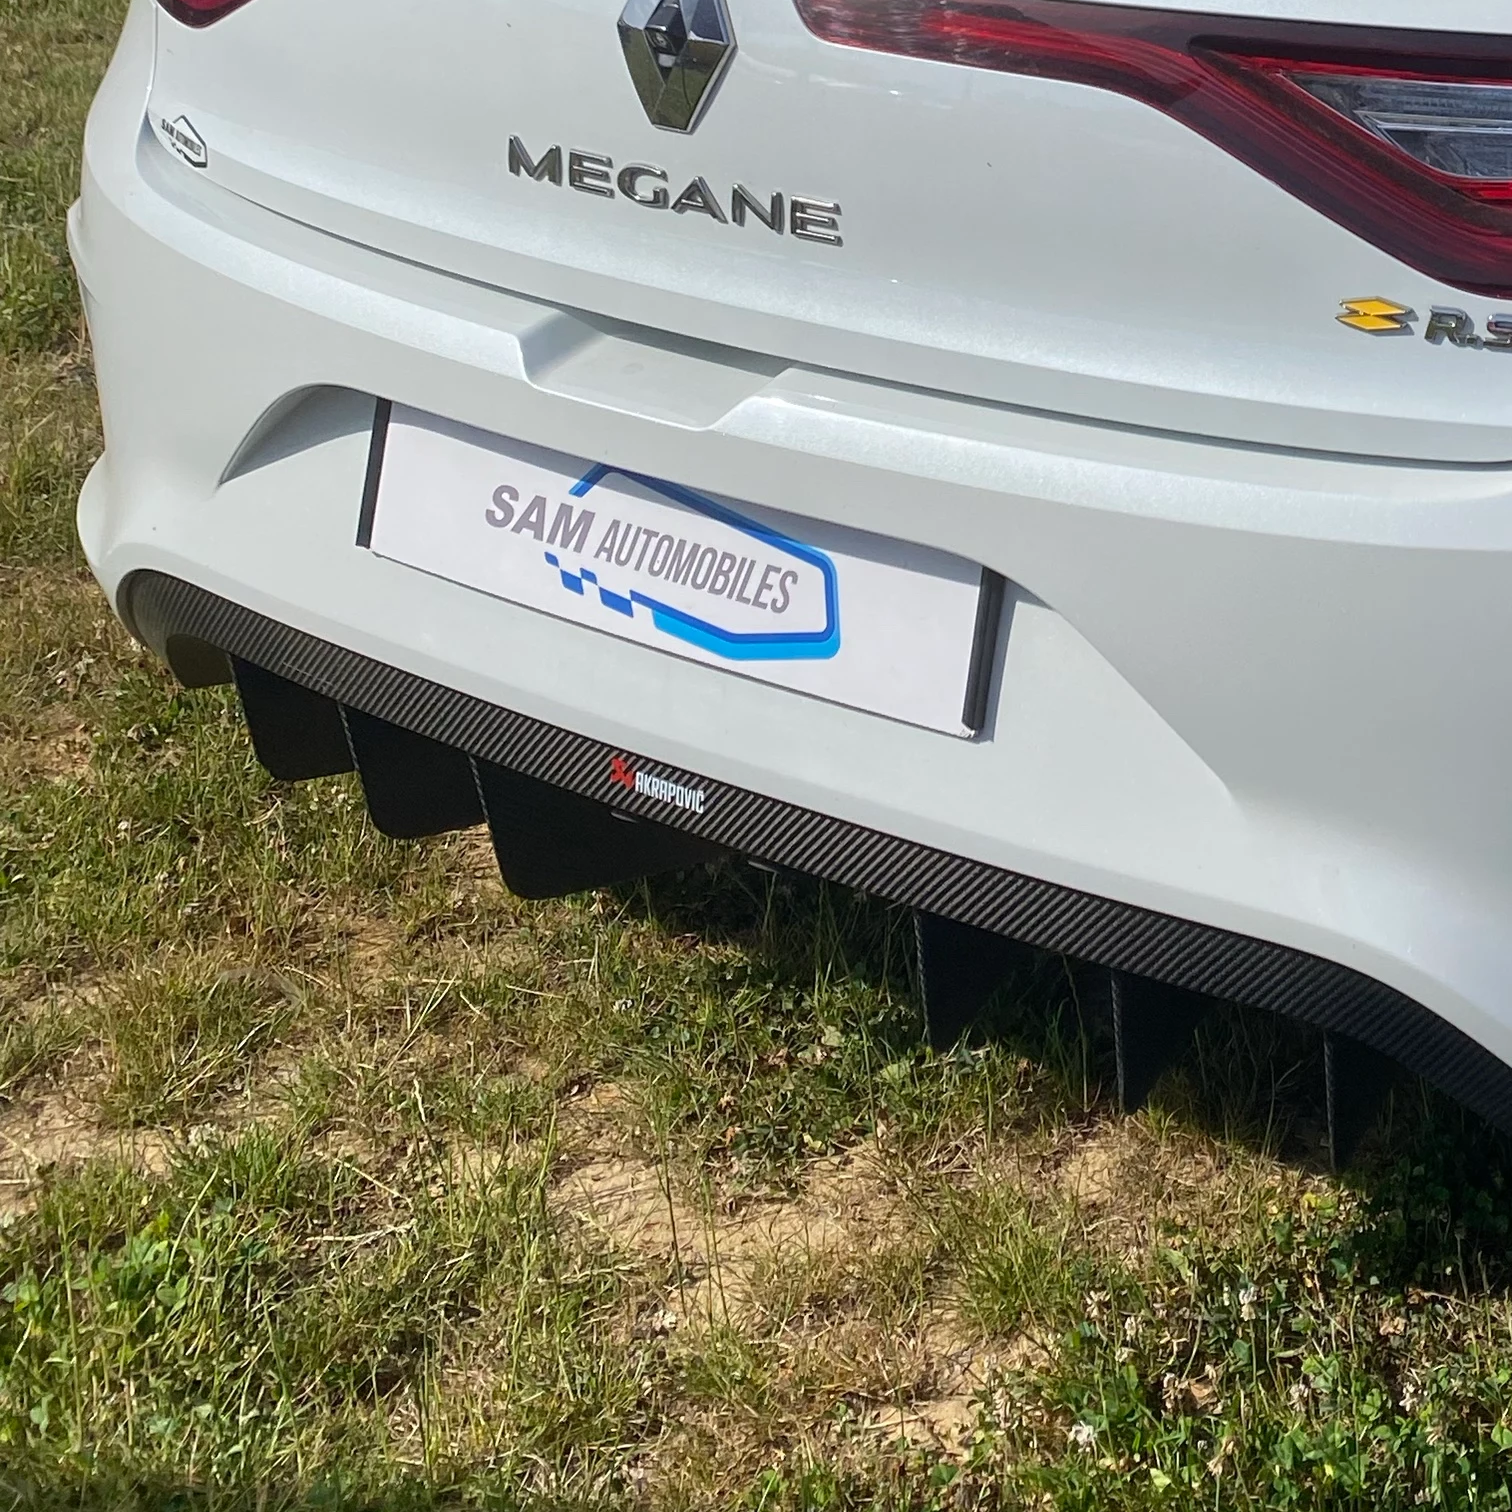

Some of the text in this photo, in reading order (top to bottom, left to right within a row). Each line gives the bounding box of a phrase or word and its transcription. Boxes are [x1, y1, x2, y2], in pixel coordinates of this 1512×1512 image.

[508, 134, 843, 247] MEGANE
[485, 484, 798, 614] SAM AUTOMOBILES
